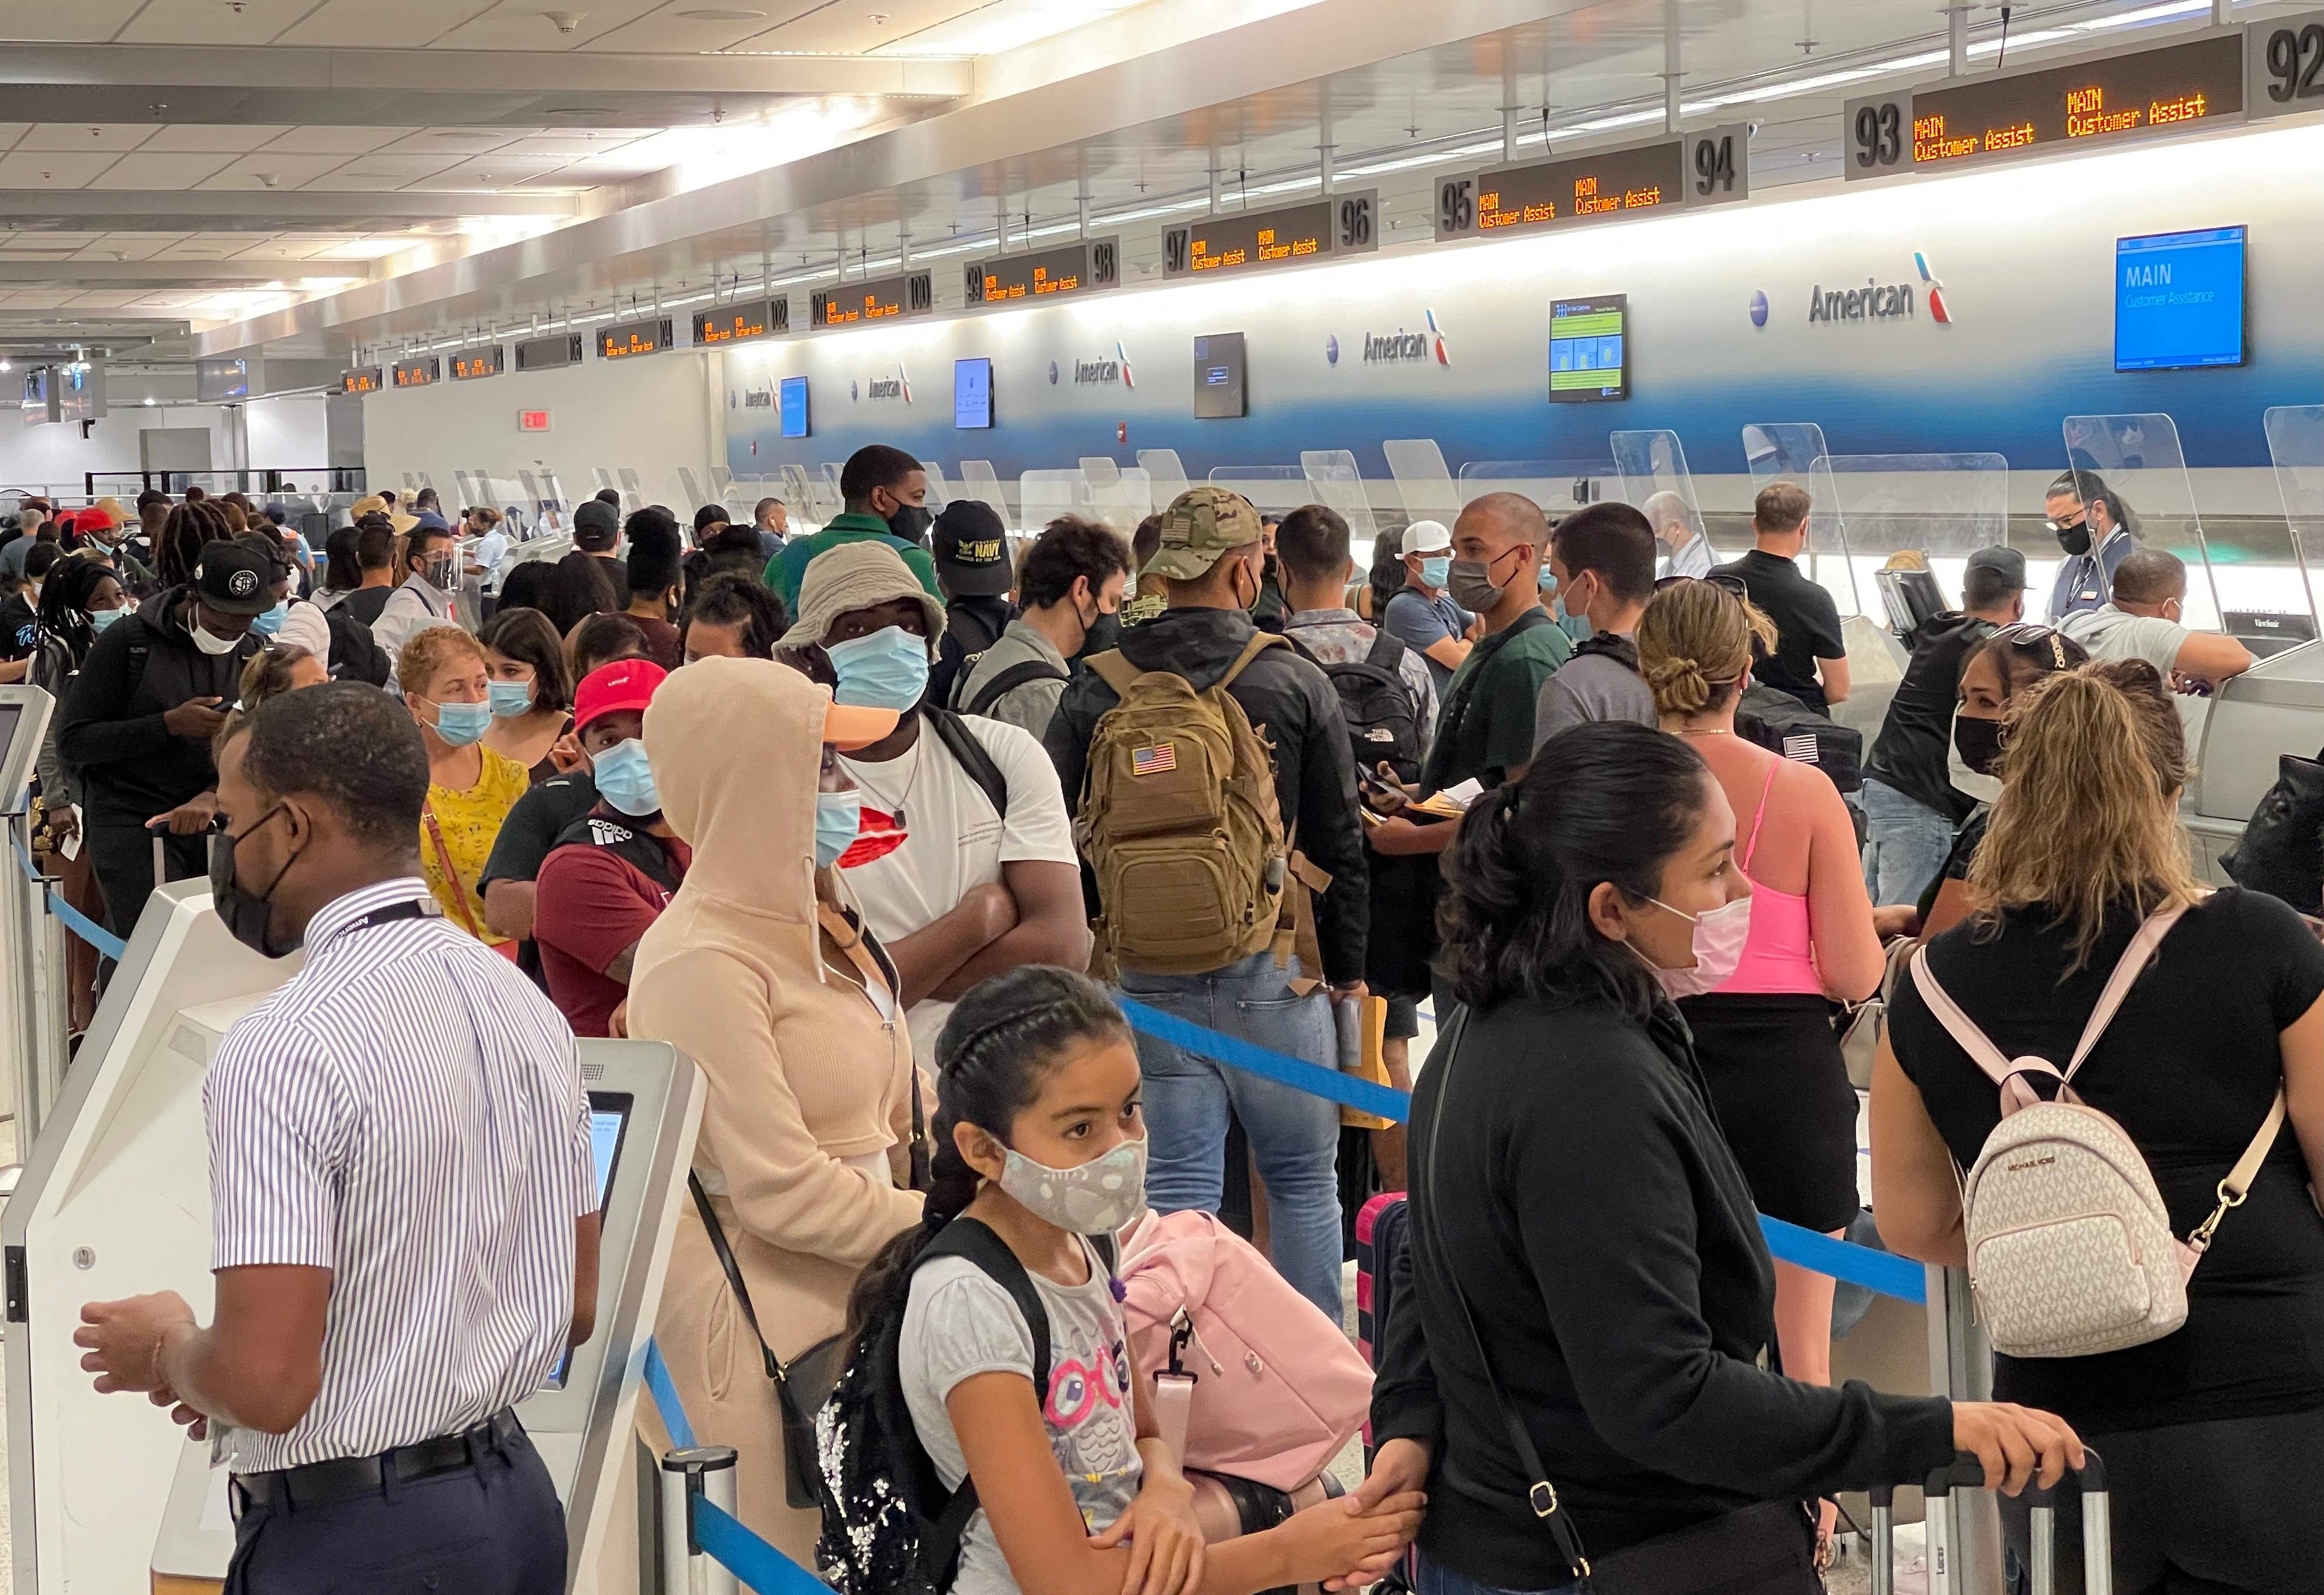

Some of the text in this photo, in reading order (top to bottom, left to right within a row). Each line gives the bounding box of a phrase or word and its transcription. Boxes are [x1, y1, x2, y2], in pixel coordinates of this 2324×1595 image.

[2268, 24, 2324, 102] 92
[2066, 86, 2102, 115] MAIN
[2066, 93, 2206, 138] Customer Assist
[1856, 104, 1899, 167] 93
[1914, 116, 1944, 141] MAIN
[1914, 123, 2035, 162] Customer Assist
[1695, 135, 1735, 196] 94
[1479, 192, 1499, 212] MAIN
[1575, 177, 1598, 198] MAIN
[1575, 186, 1661, 215] Customer Assist
[1341, 198, 1369, 246] 96
[1441, 180, 1471, 232] 95
[1479, 202, 1555, 229] Customer Assist
[1166, 229, 1187, 272] 97
[1223, 248, 1246, 266] Assist
[1293, 237, 1318, 255] Assist
[1094, 243, 1114, 282] 98
[2126, 264, 2171, 288] MAIN
[911, 275, 931, 310] 100
[967, 265, 982, 302] 99
[2125, 291, 2215, 308] Customer Assistance
[813, 293, 827, 325] 101
[1809, 278, 1913, 322] American
[1363, 328, 1428, 361] American
[1075, 356, 1118, 382] American
[975, 542, 1000, 558] NAVY
[588, 819, 633, 840] adidas
